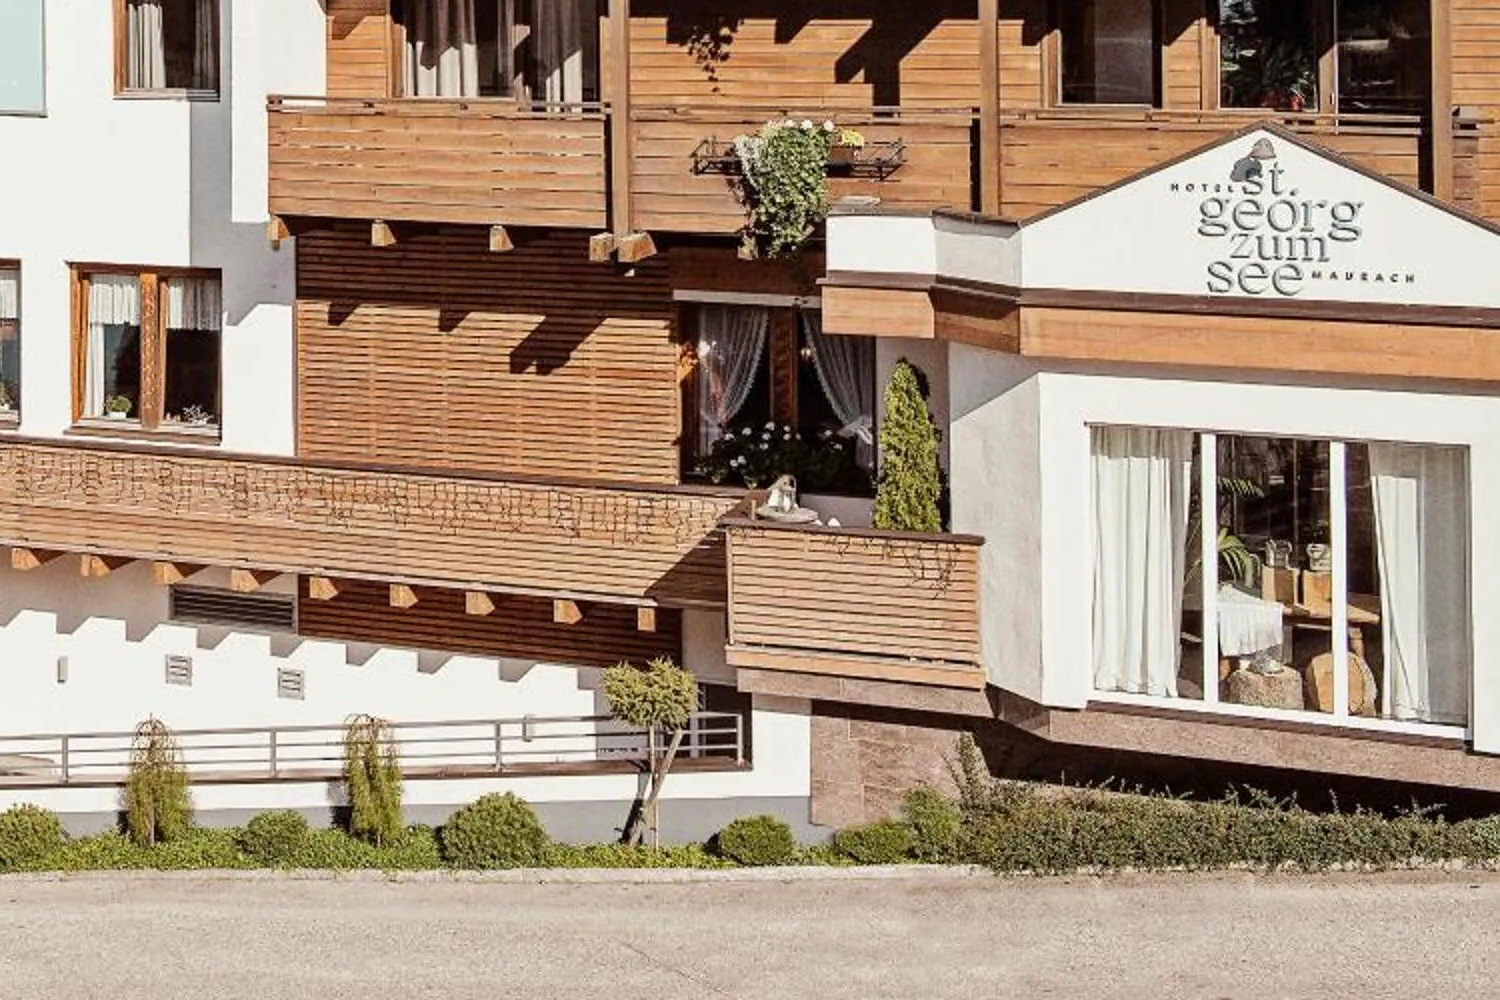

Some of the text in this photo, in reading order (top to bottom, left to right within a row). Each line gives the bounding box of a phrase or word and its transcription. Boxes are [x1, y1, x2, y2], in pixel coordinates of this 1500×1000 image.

[1170, 162, 1299, 196] HOTEL st.
[1197, 197, 1365, 242] georg
[1229, 232, 1330, 263] zum
[1206, 260, 1416, 296] see MAURACH
